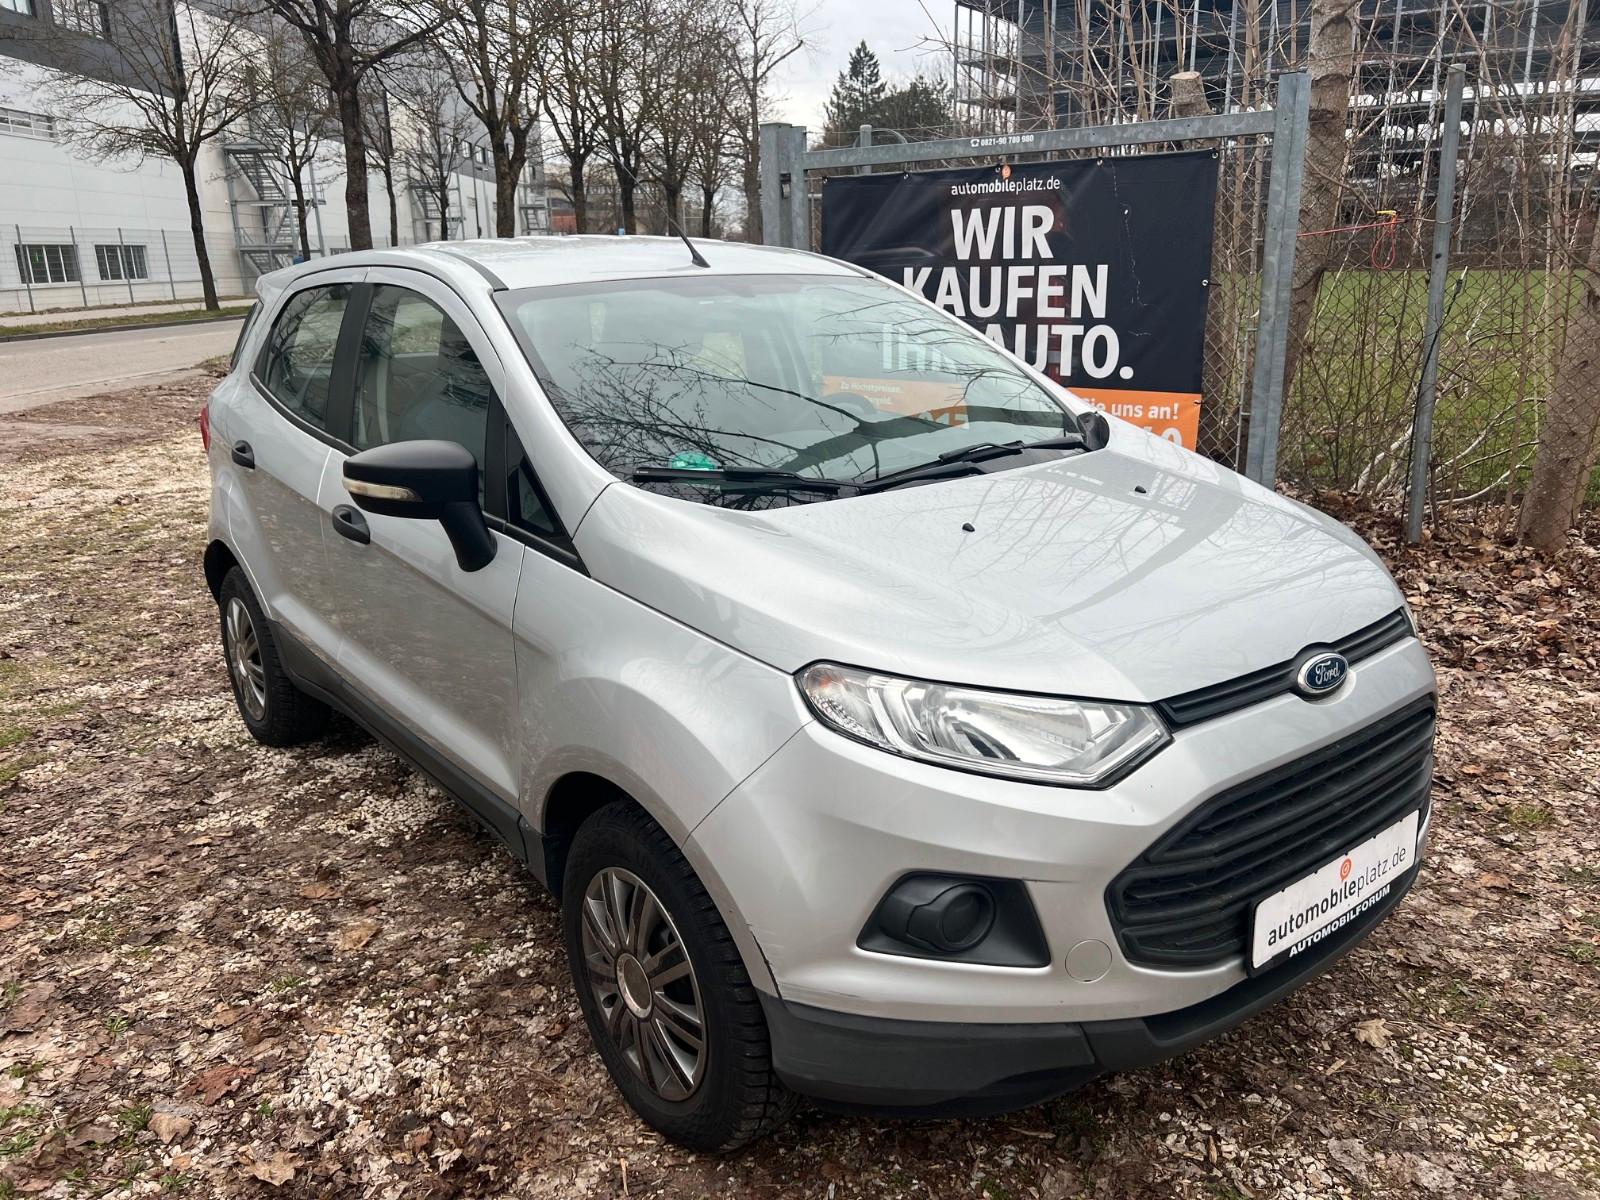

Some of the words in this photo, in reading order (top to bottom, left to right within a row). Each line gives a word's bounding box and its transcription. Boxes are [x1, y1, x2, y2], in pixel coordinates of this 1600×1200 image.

[980, 136, 1007, 147] 0821-90
[951, 175, 1061, 195] automobileplatz.de
[950, 205, 1055, 260] WIR
[903, 264, 1109, 318] KAUFEN
[1111, 404, 1143, 418] uns
[1148, 402, 1179, 420] an!
[1315, 660, 1340, 685] Ford
[1267, 847, 1406, 946] automobileplatz.de
[1289, 884, 1391, 957] AUTOMOBILFORUM
